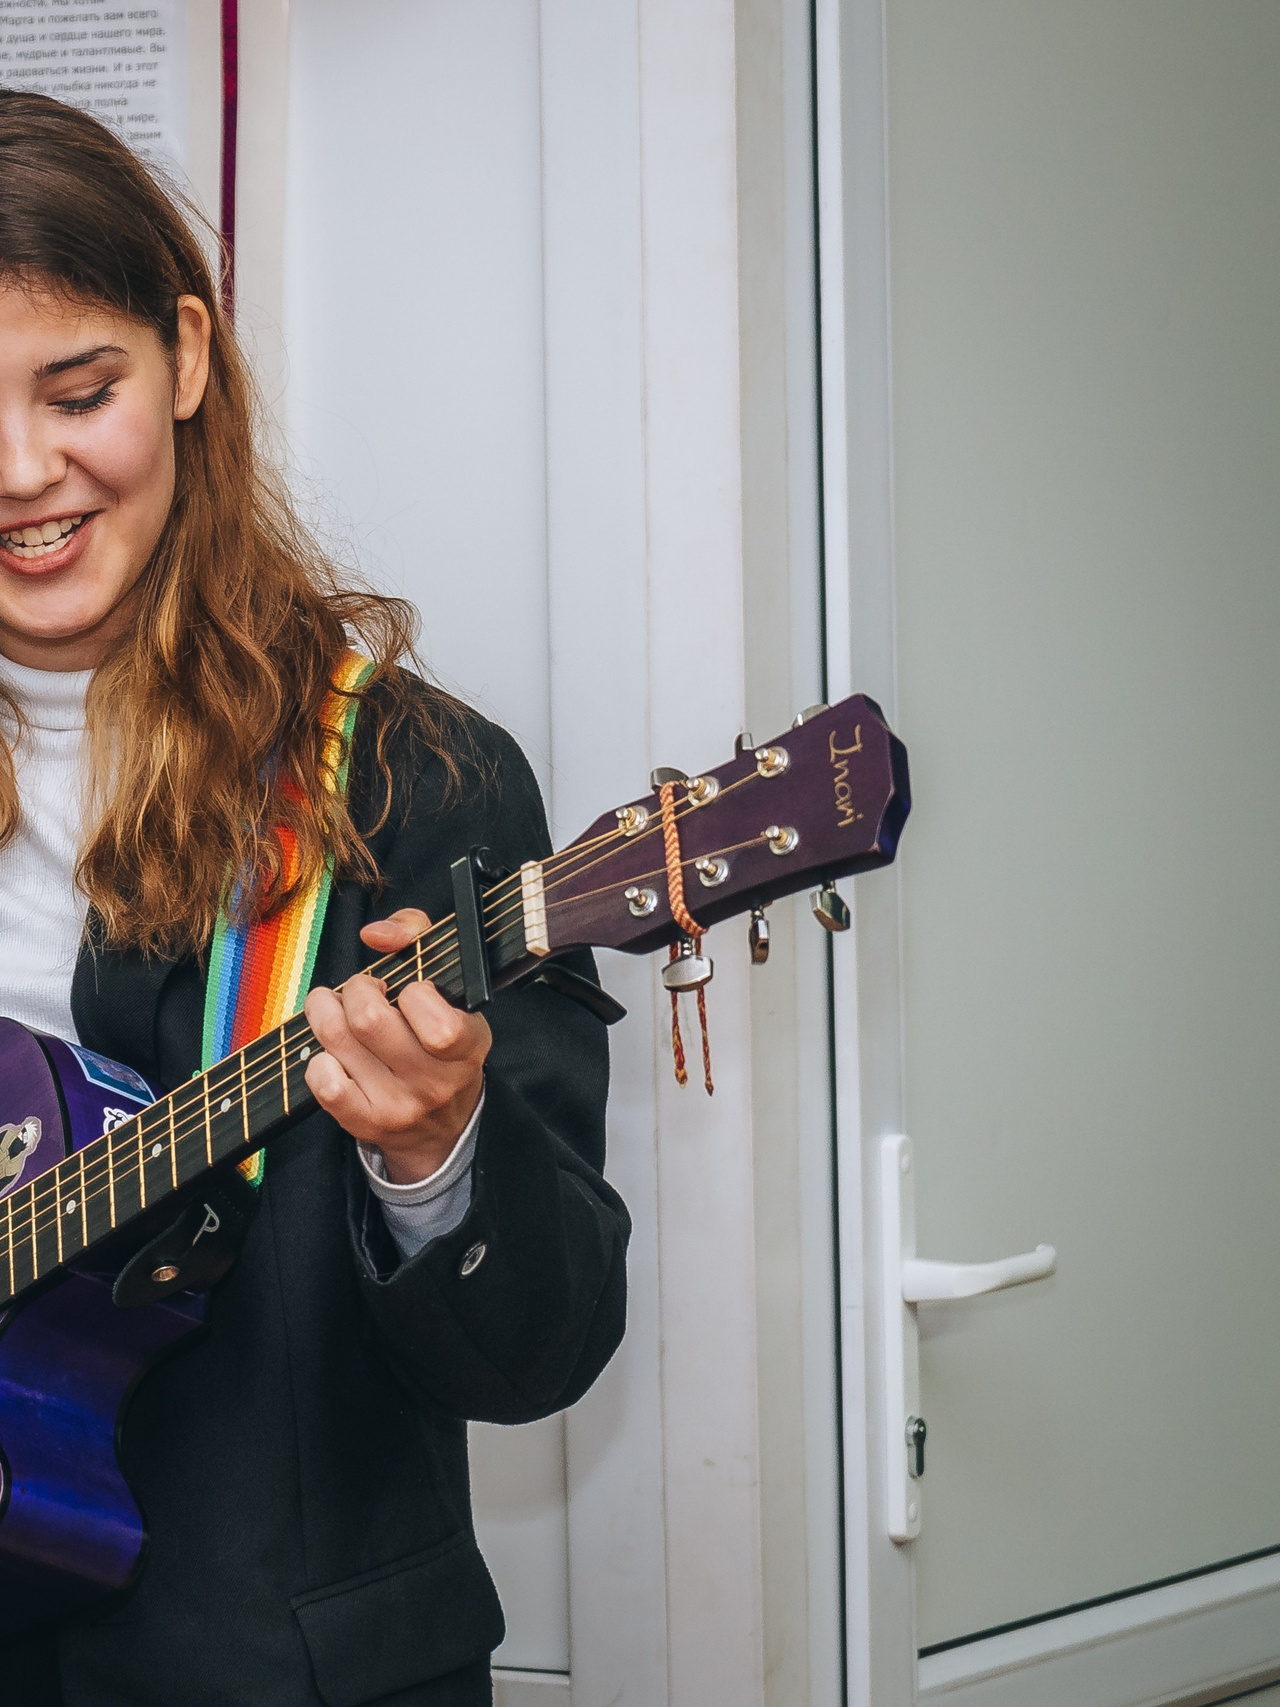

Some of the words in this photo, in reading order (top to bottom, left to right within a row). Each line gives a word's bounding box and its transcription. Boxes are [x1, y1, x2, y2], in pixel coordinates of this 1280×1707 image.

[0, 15, 34, 29] Марта
[48, 13, 100, 26] пожелать
[103, 12, 124, 21] вам
[127, 10, 158, 19] всего
[6, 34, 36, 46] душа
[91, 29, 132, 40] нашего
[150, 42, 166, 54] Вы
